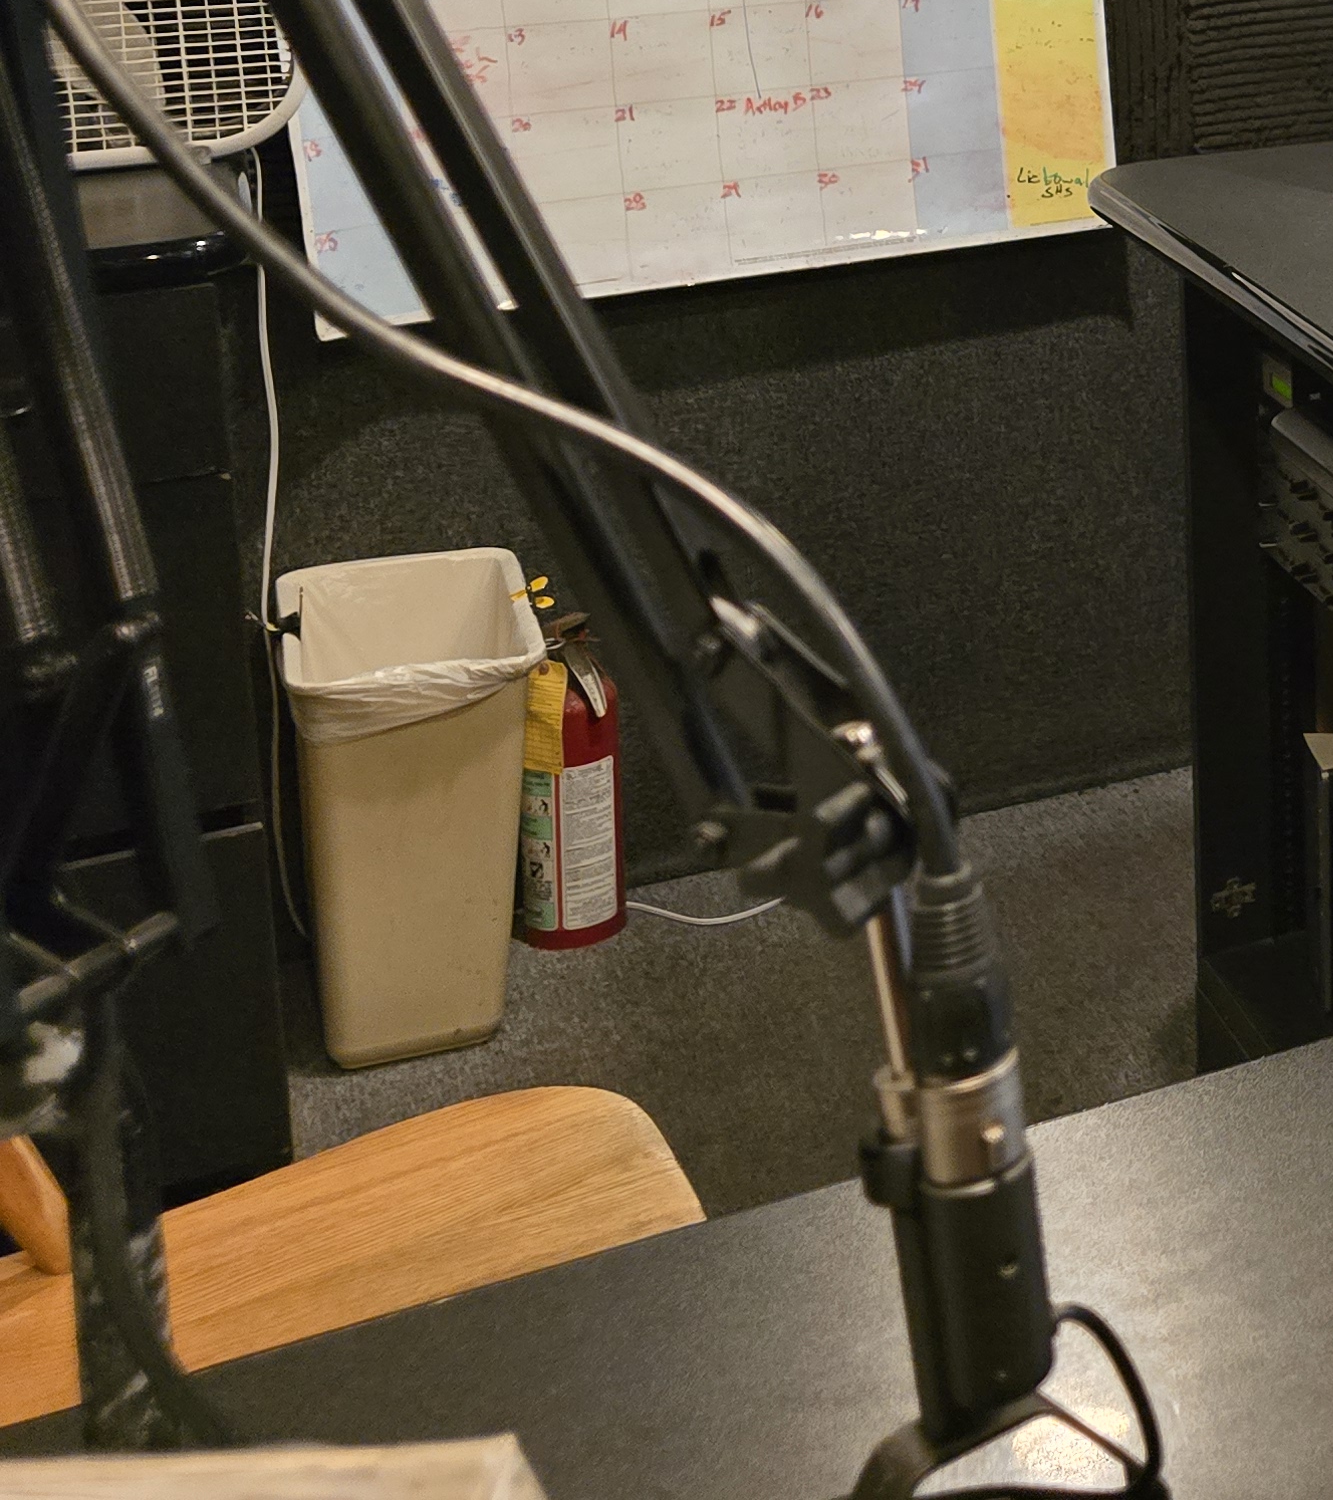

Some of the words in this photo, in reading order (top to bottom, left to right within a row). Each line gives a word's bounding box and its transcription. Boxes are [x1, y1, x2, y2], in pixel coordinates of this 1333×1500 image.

[610, 20, 629, 41] 14
[710, 10, 731, 27] 15
[805, 4, 824, 19] 16
[614, 105, 635, 122] 21
[715, 99, 736, 113] 22
[809, 87, 832, 100] 23
[623, 192, 647, 212] 28
